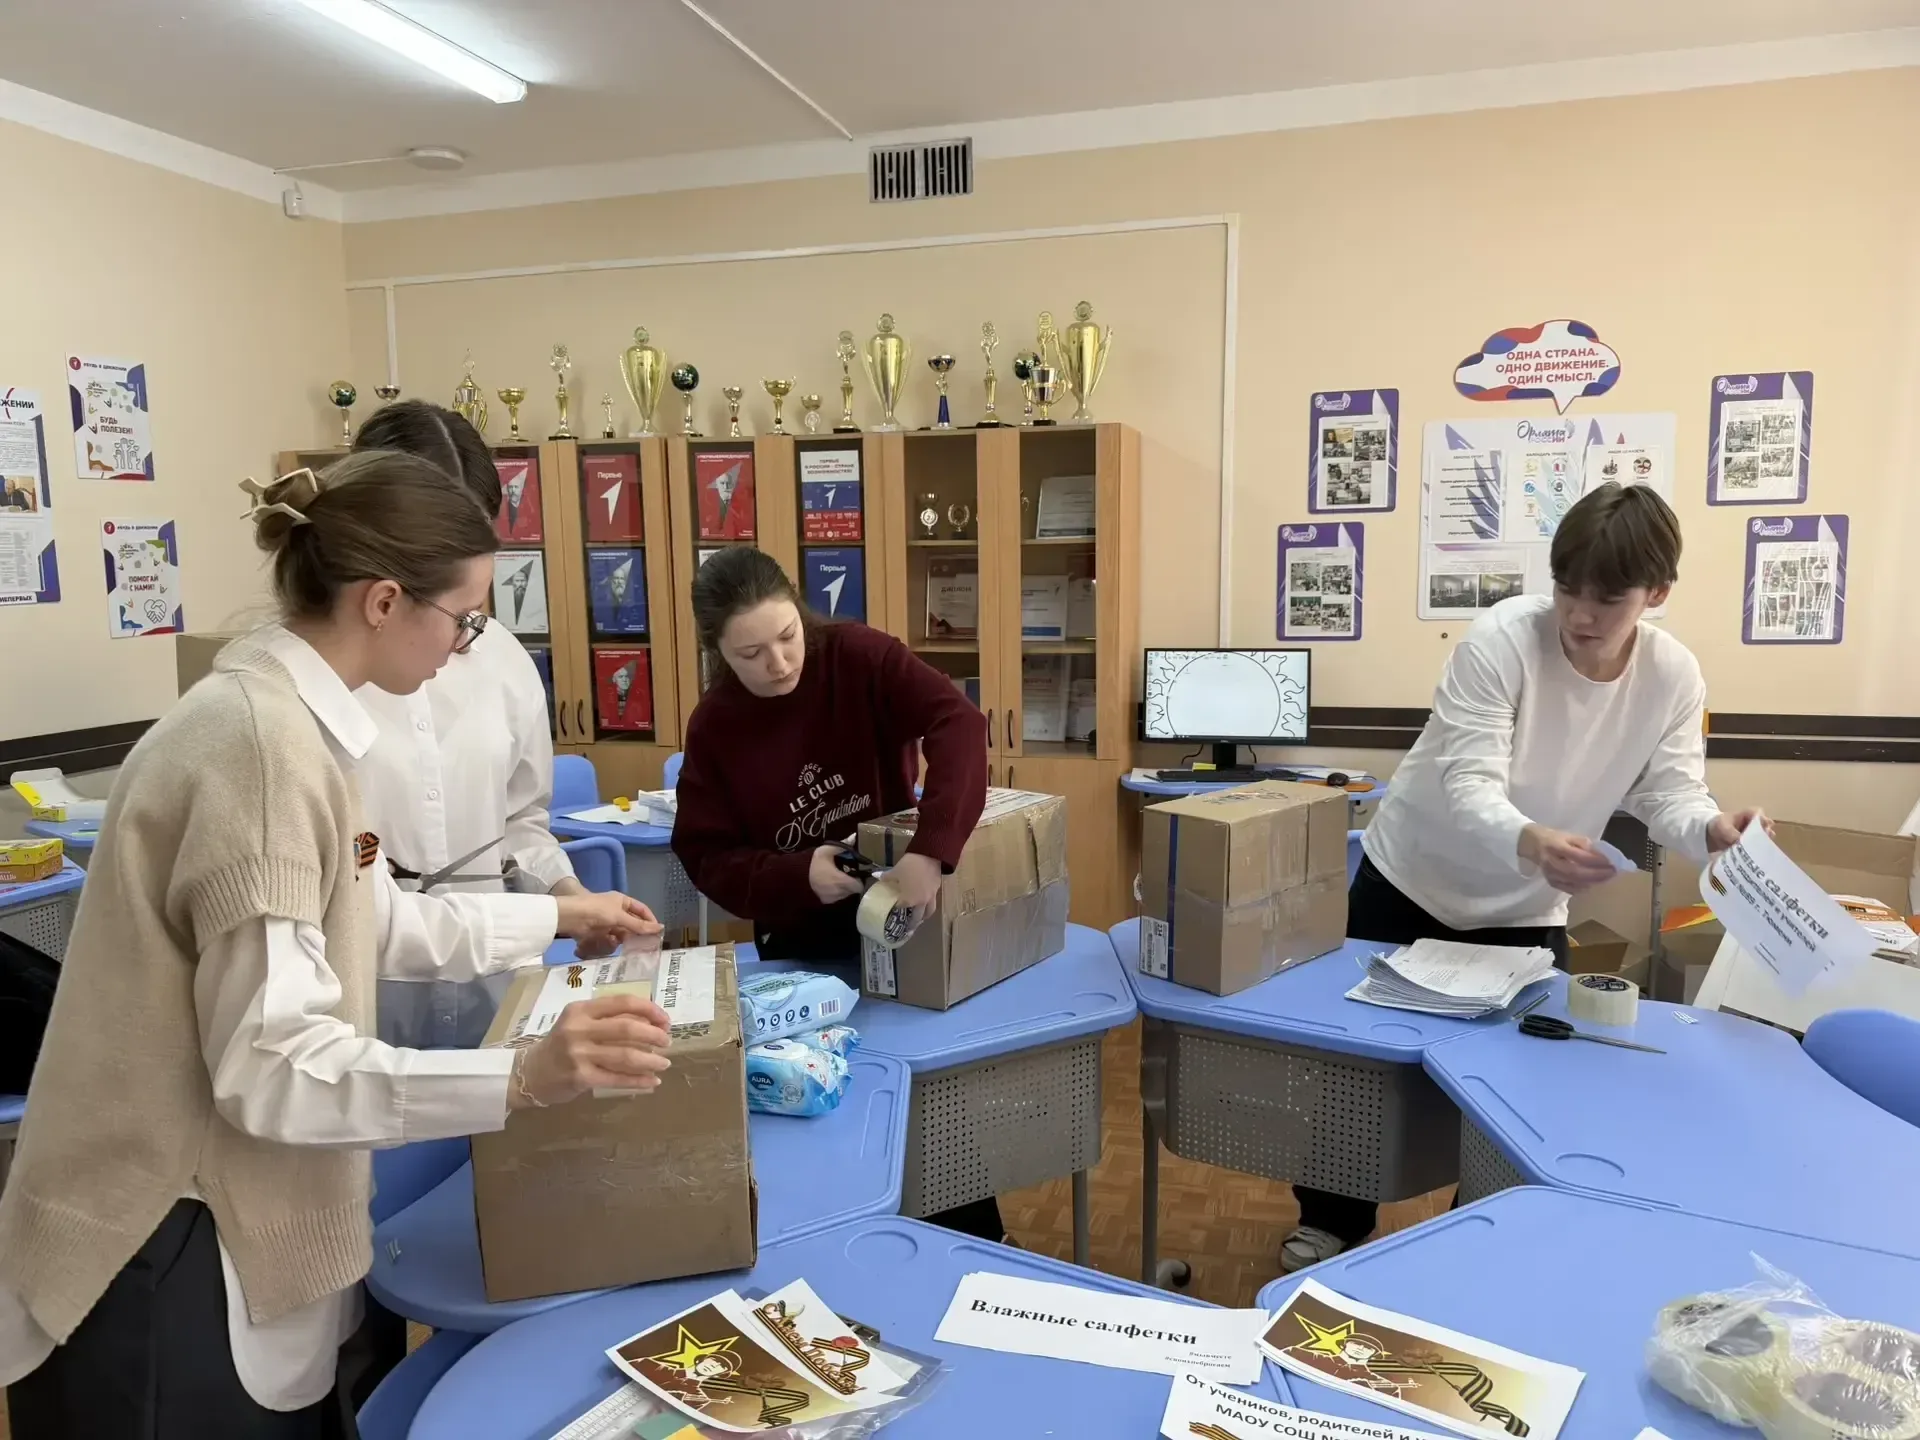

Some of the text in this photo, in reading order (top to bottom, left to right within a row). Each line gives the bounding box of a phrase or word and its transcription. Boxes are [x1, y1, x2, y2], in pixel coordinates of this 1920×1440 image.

[1506, 347, 1599, 361] ОДНА СТРАНА.
[1496, 359, 1609, 374] ОДНО ДВИЖЕНИЕ.
[1507, 372, 1596, 385] ОДИН СМЫСЛ.
[99, 415, 118, 425] БУДЬ
[1516, 419, 1566, 441] Орлята
[597, 471, 623, 480] Первые
[820, 563, 847, 573] Первые
[128, 574, 159, 583] ПОМОГАЙ
[134, 583, 156, 592] НАМИ!
[789, 773, 845, 813] LE CLUB
[1764, 876, 1829, 939] салфетки
[751, 1075, 772, 1085] AURA
[970, 1298, 1197, 1345] Влажные салфетки
[1186, 1373, 1206, 1388] От
[1209, 1386, 1293, 1421] учеников,
[1298, 1414, 1394, 1440] родителей
[1216, 1403, 1316, 1440] МАОУ СОШ
